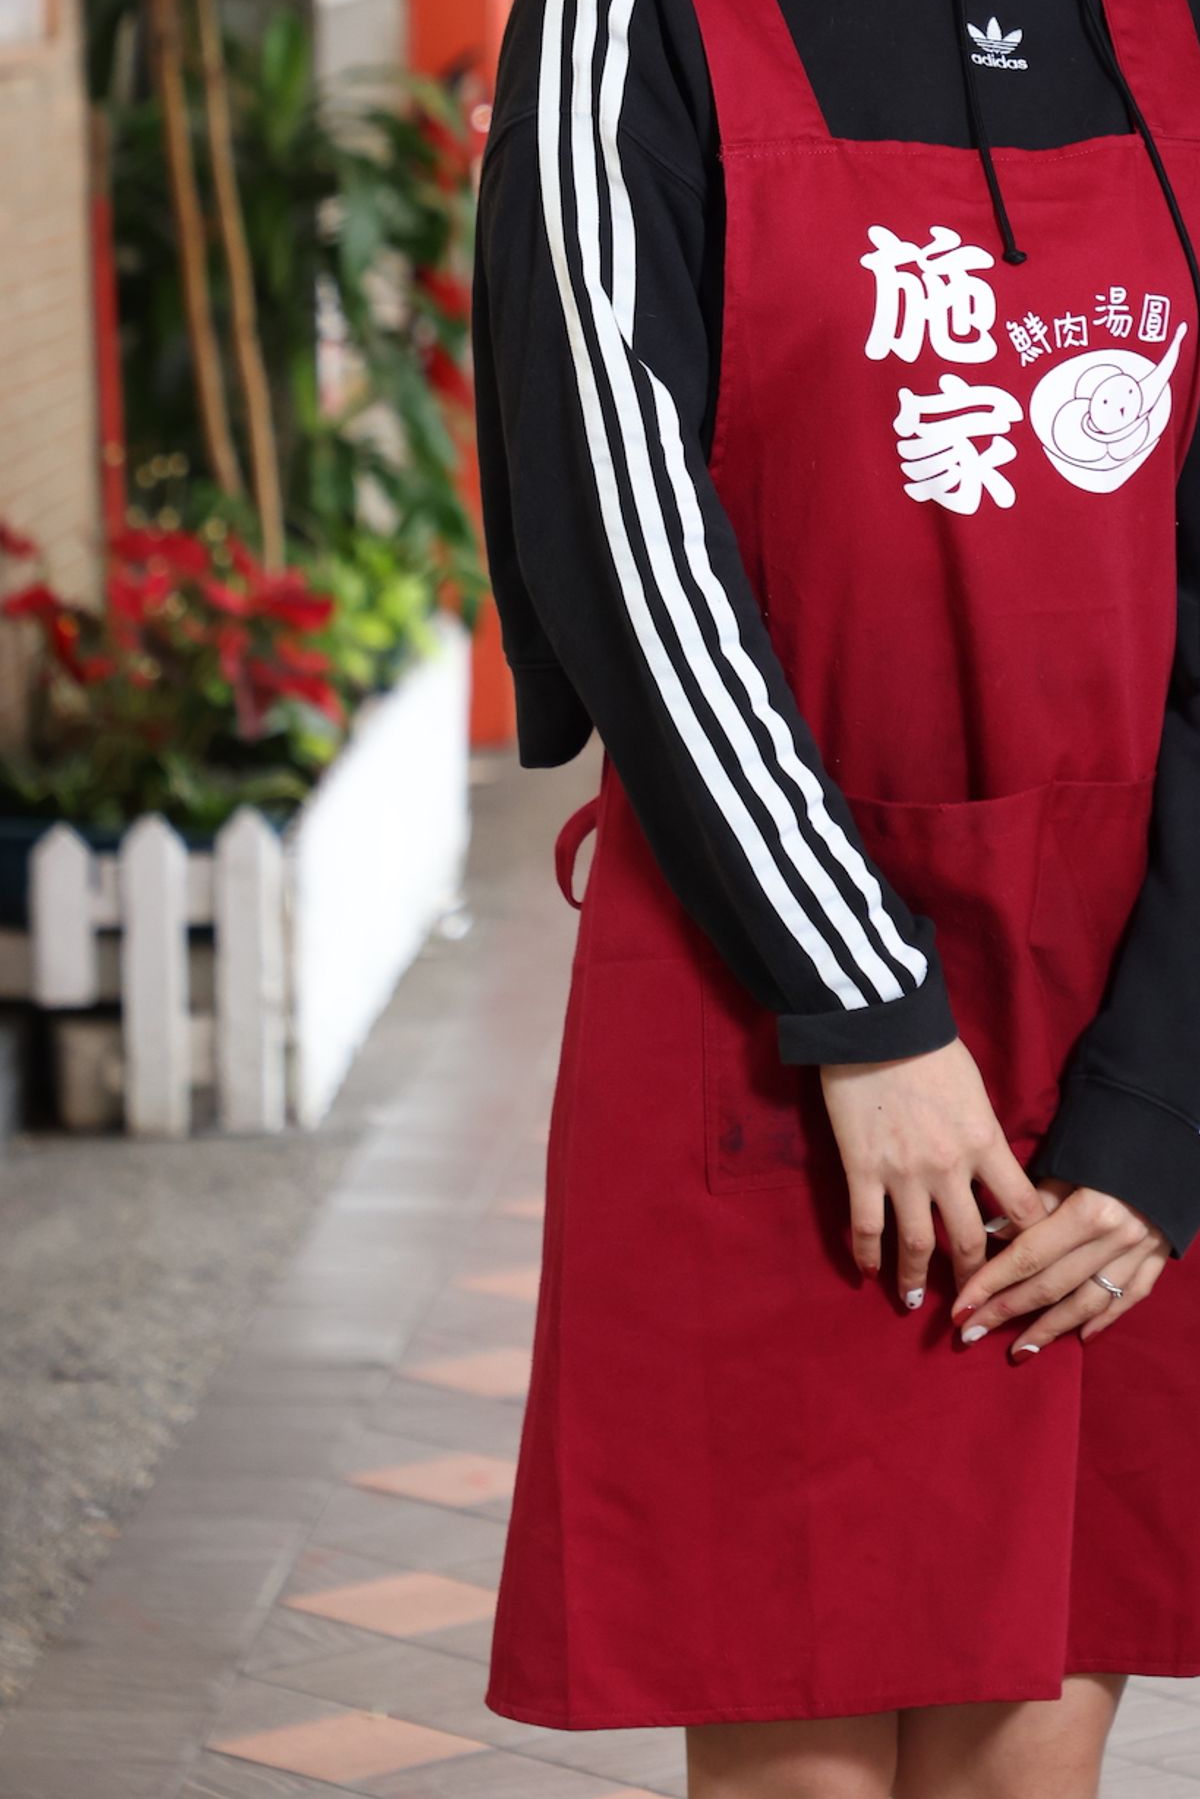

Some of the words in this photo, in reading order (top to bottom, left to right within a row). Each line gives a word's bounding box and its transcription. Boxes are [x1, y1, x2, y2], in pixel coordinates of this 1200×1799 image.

[971, 51, 1028, 71] adidas
[1006, 286, 1171, 367] 鮮肉湯圓
[860, 225, 1024, 516] 施家
